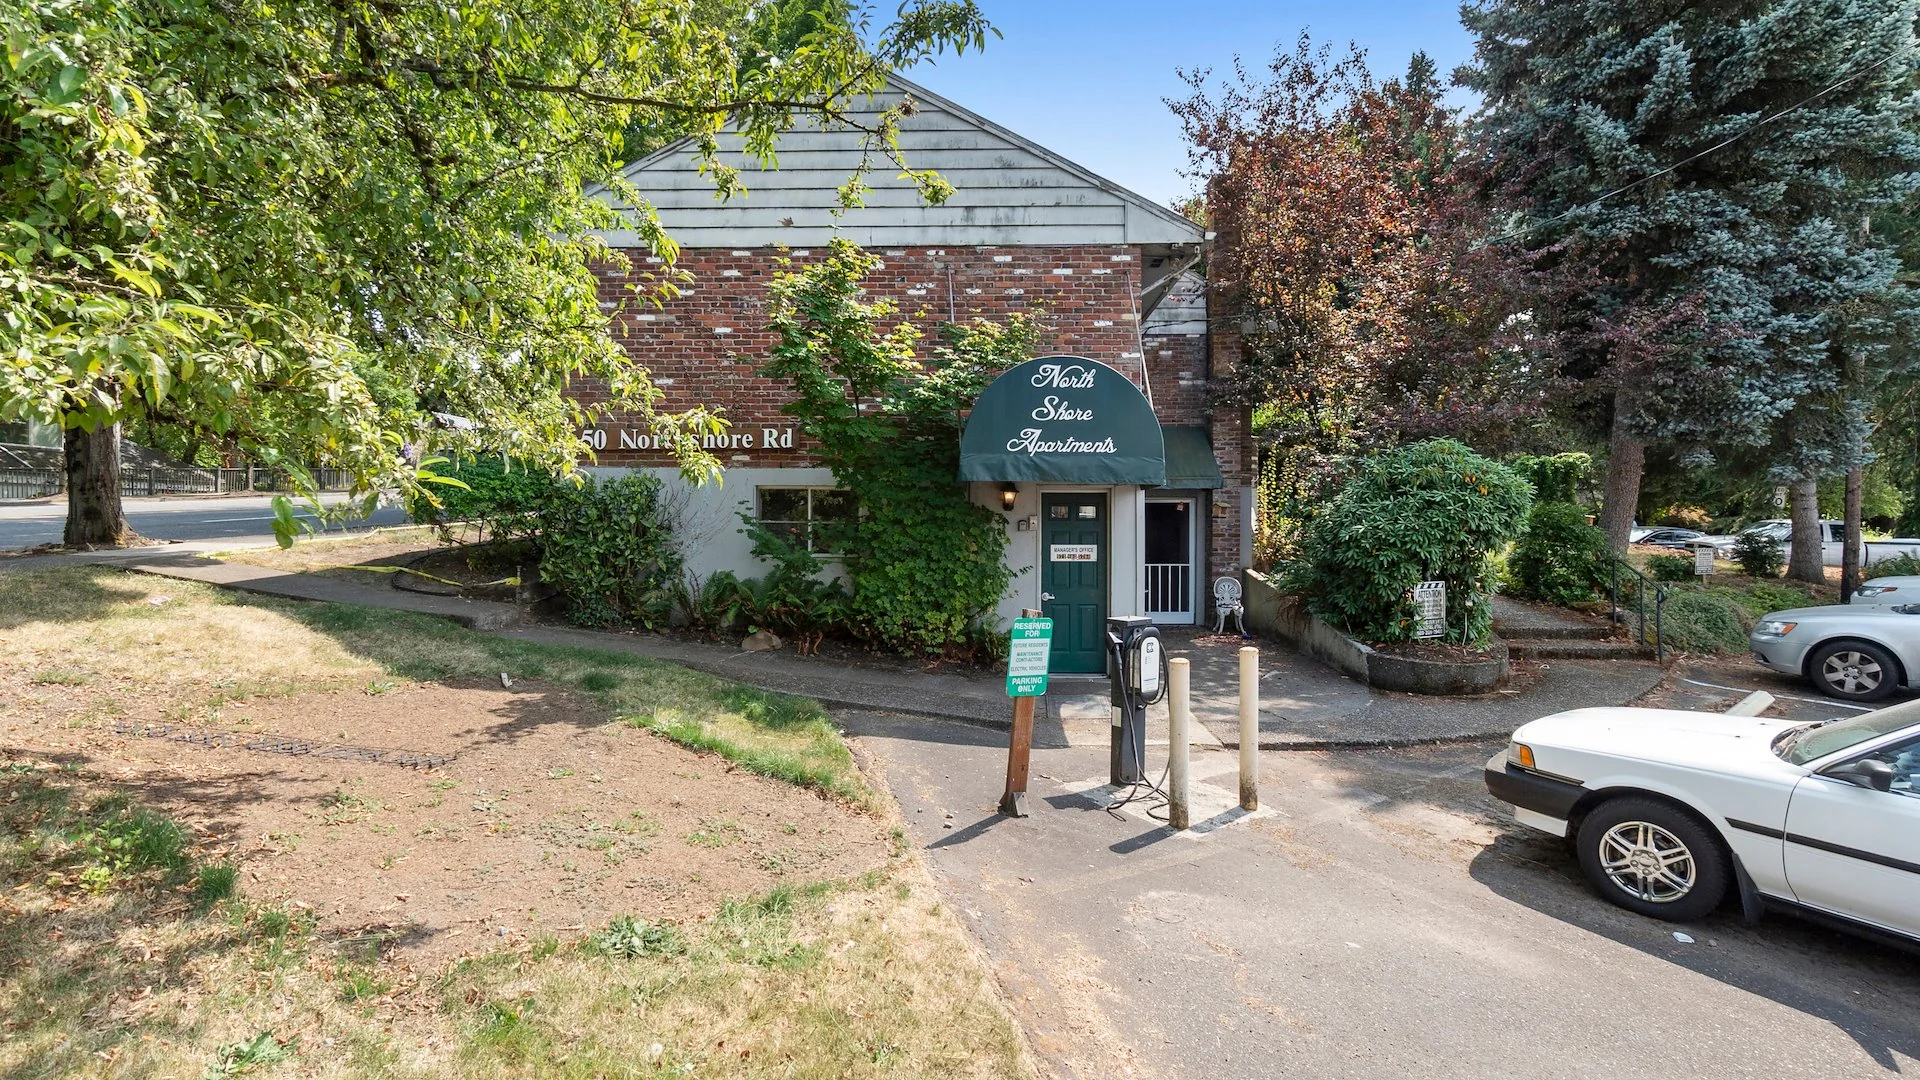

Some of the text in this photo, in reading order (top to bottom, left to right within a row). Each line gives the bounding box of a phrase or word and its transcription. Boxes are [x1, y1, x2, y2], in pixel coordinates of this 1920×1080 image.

[1030, 363, 1097, 389] North
[1031, 395, 1094, 422] Shore
[761, 428, 793, 449] Rd
[1006, 427, 1118, 457] Apartments
[1417, 590, 1442, 599] ATTENTION
[1014, 622, 1051, 630] RESERVED
[1024, 630, 1040, 638] FOR
[1012, 677, 1042, 686] PARKING
[1017, 685, 1036, 693] ONLY
